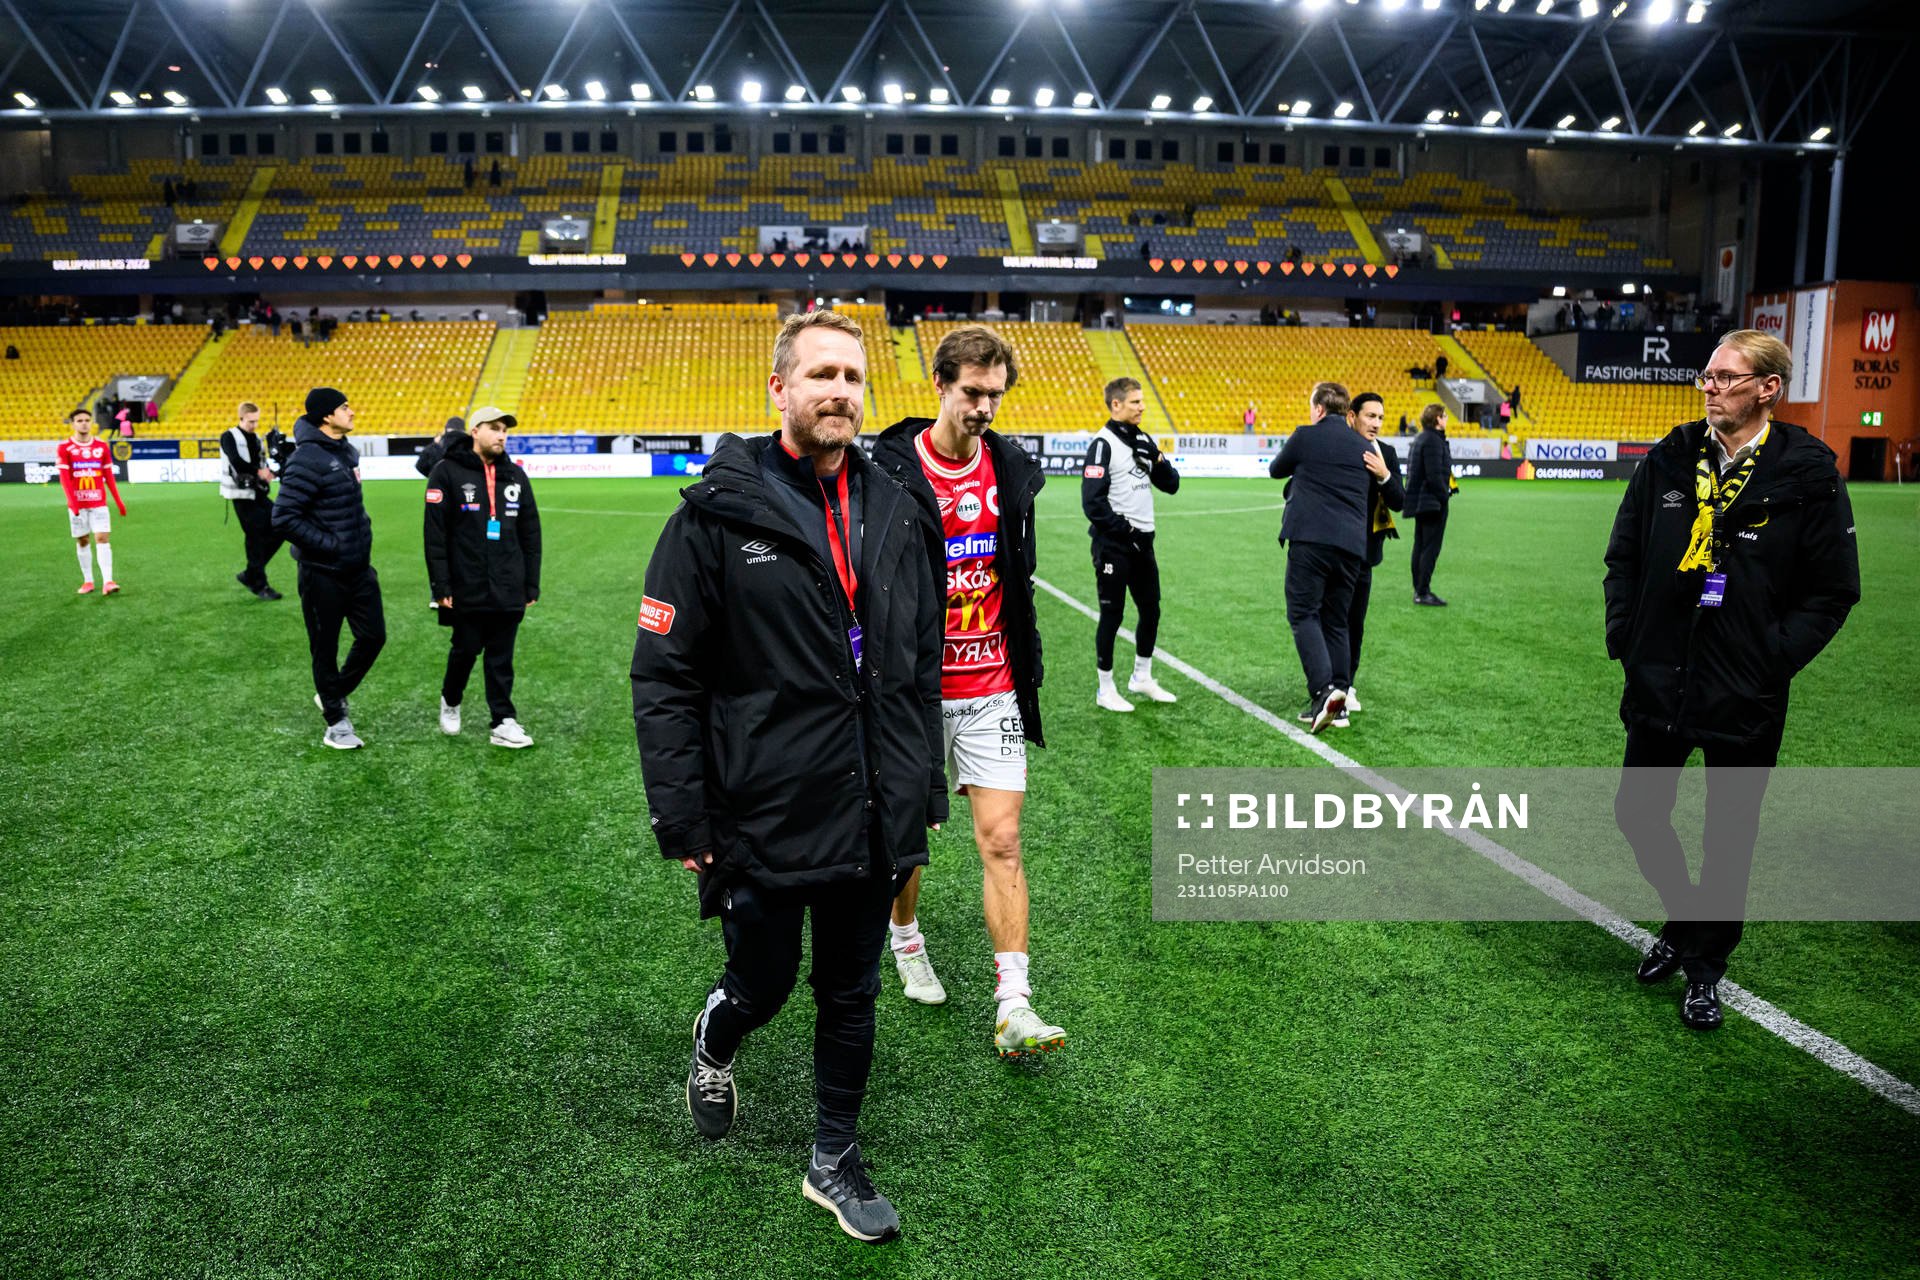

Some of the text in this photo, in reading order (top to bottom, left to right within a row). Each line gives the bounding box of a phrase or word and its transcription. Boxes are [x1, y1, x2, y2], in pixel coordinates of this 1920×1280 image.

[1643, 336, 1671, 363] FR
[1852, 358, 1899, 373] BORÅS
[1855, 376, 1891, 389] STAD
[1051, 437, 1088, 451] front
[1179, 438, 1227, 448] BEIJER
[1536, 444, 1606, 460] Nordea
[1536, 468, 1604, 480] OLOFSSON BYGG
[953, 480, 981, 493] Helmia
[957, 503, 980, 513] MHE
[746, 554, 778, 565] umbro
